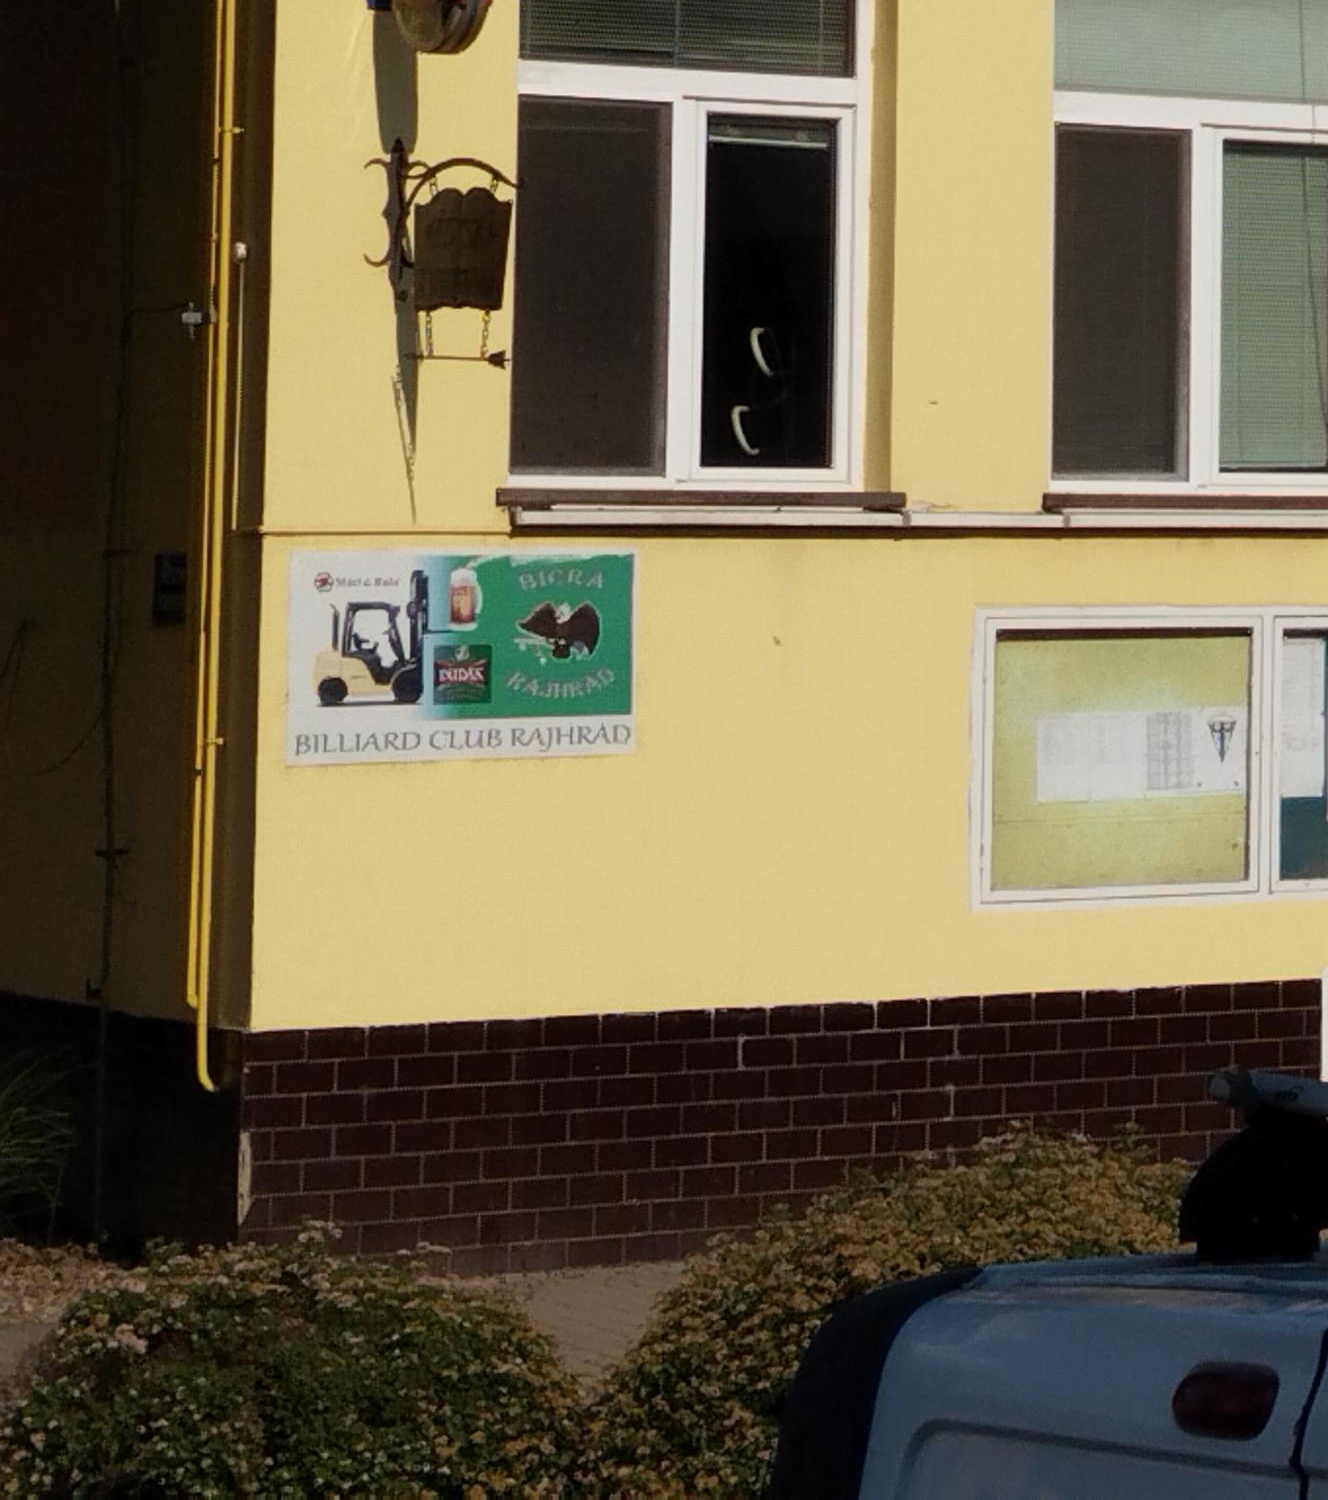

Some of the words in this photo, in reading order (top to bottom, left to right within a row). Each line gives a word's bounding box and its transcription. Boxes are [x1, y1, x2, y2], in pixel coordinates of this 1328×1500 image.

[507, 668, 614, 698] RAJHRAD
[295, 732, 421, 756] BILLIARD
[429, 729, 502, 750] CLUB
[511, 723, 631, 752] RAJHRAD
